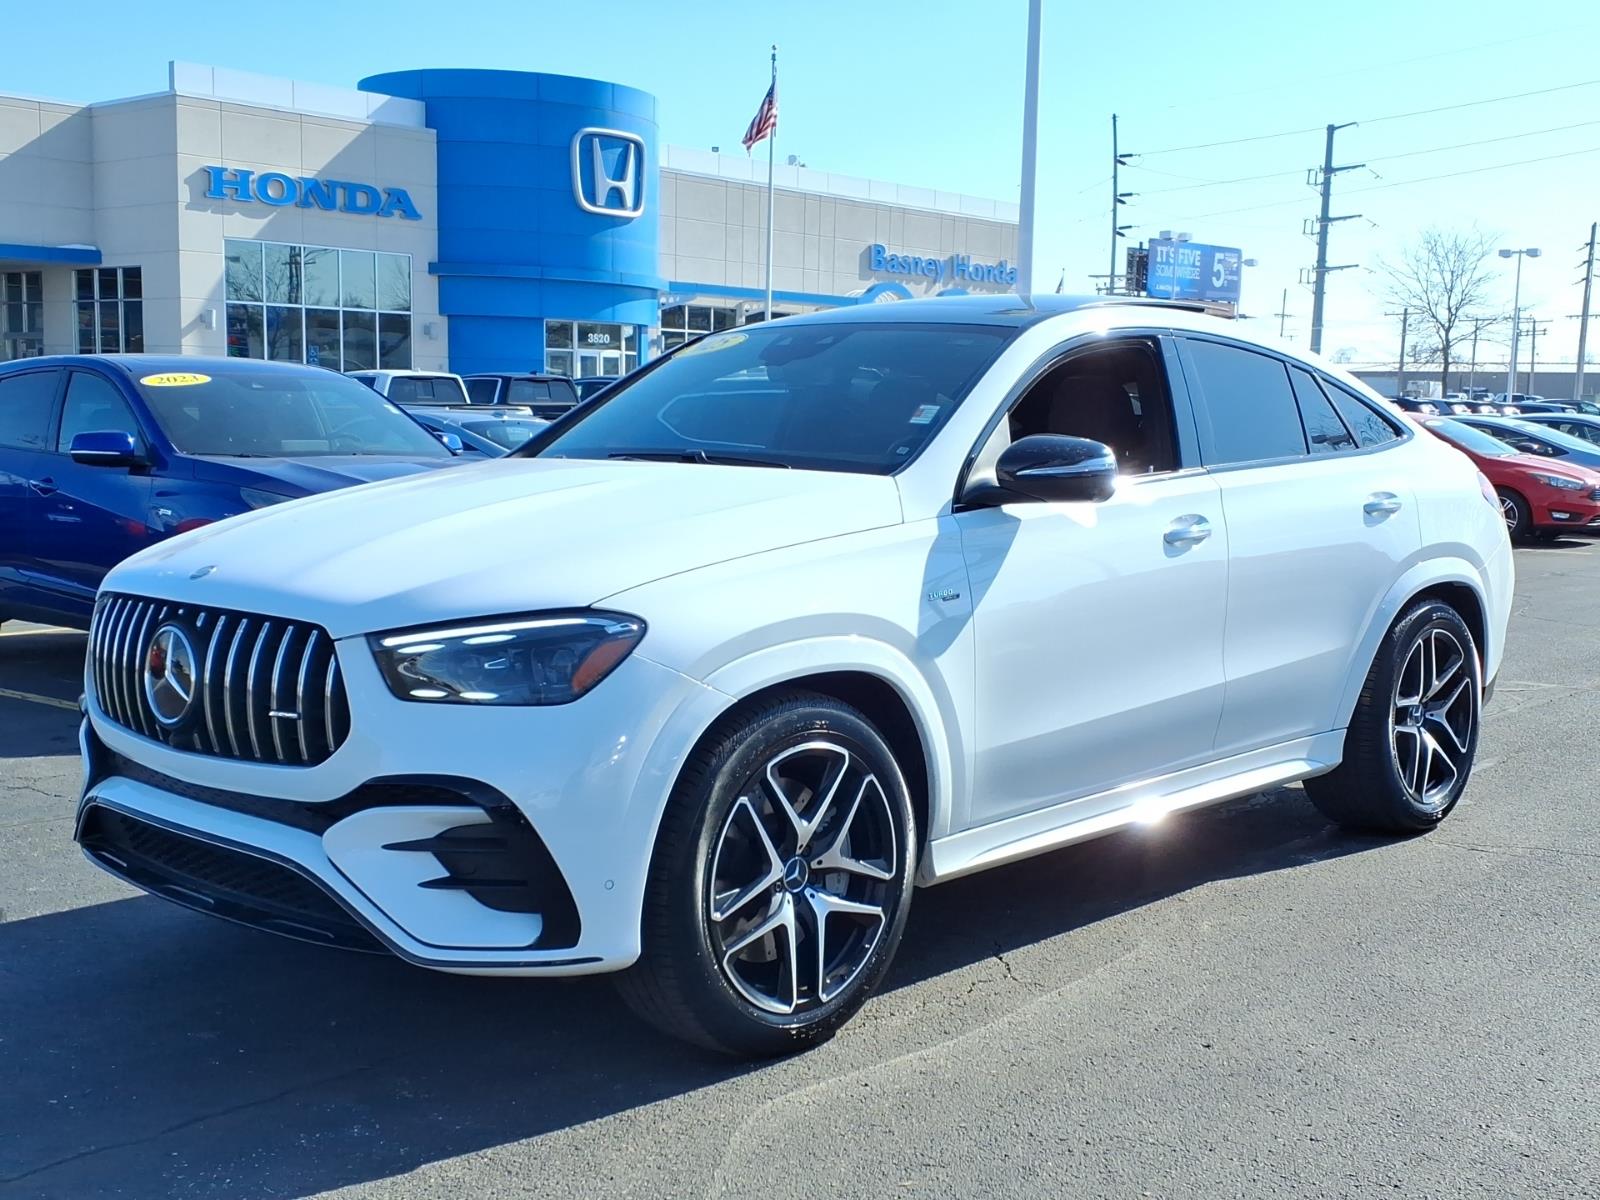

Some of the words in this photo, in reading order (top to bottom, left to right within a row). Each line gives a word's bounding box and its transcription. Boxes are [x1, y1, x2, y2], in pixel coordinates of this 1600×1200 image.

[204, 165, 422, 221] HONDA
[870, 243, 945, 285] Basney
[952, 253, 1017, 286] Honda
[1156, 246, 1175, 264] IT'S
[1178, 248, 1201, 267] FIVE
[1154, 264, 1201, 280] SOMWHERE
[1211, 252, 1225, 288] 5
[587, 333, 610, 344] 3820
[157, 375, 199, 385] 2023
